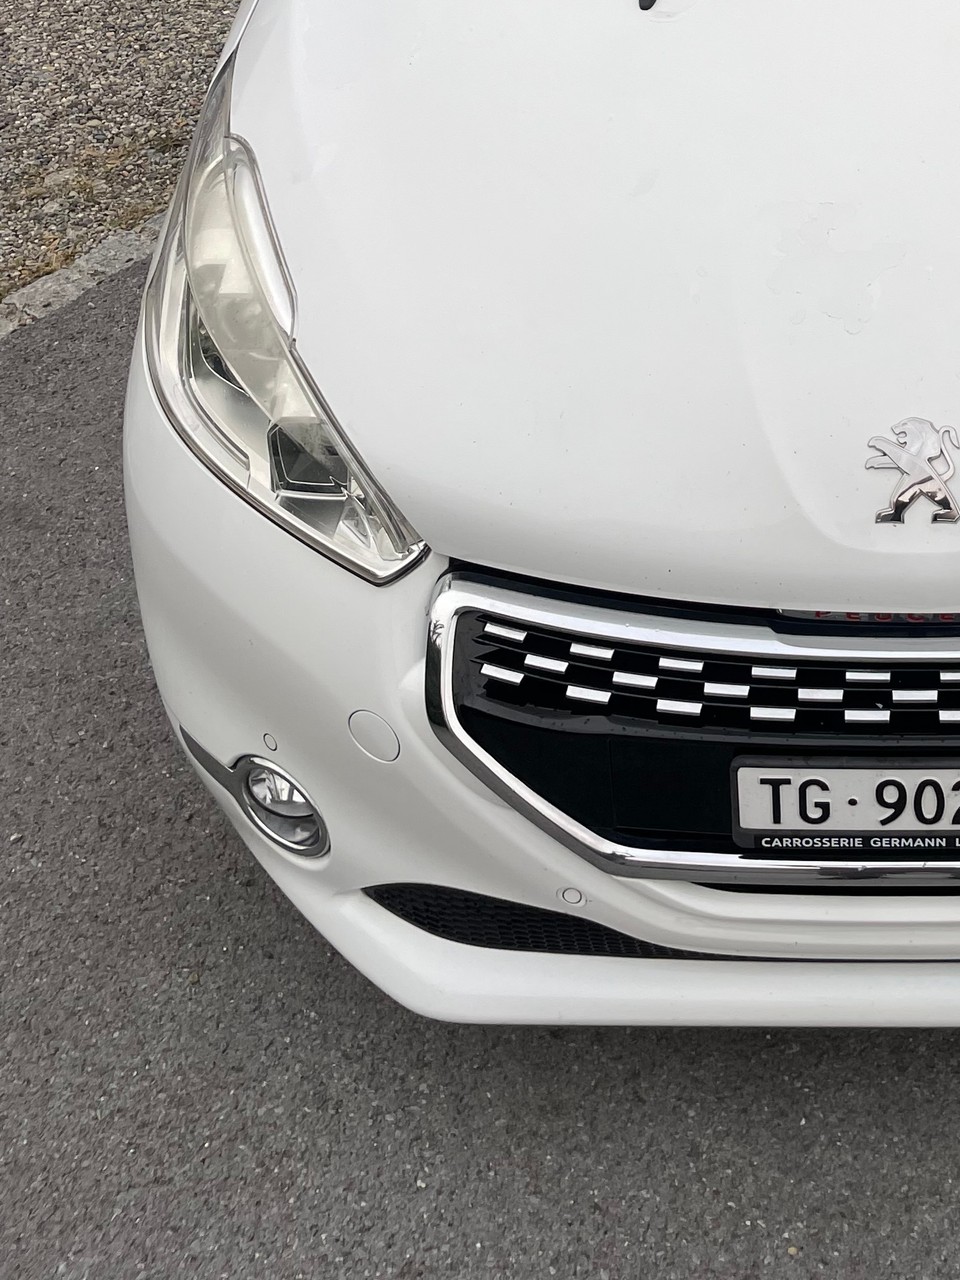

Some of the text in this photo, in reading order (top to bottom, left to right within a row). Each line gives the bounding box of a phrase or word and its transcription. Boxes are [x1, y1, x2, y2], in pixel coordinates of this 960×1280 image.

[759, 778, 831, 825] TG
[761, 837, 863, 848] CARROSSERIE
[870, 837, 947, 848] GERMANN
